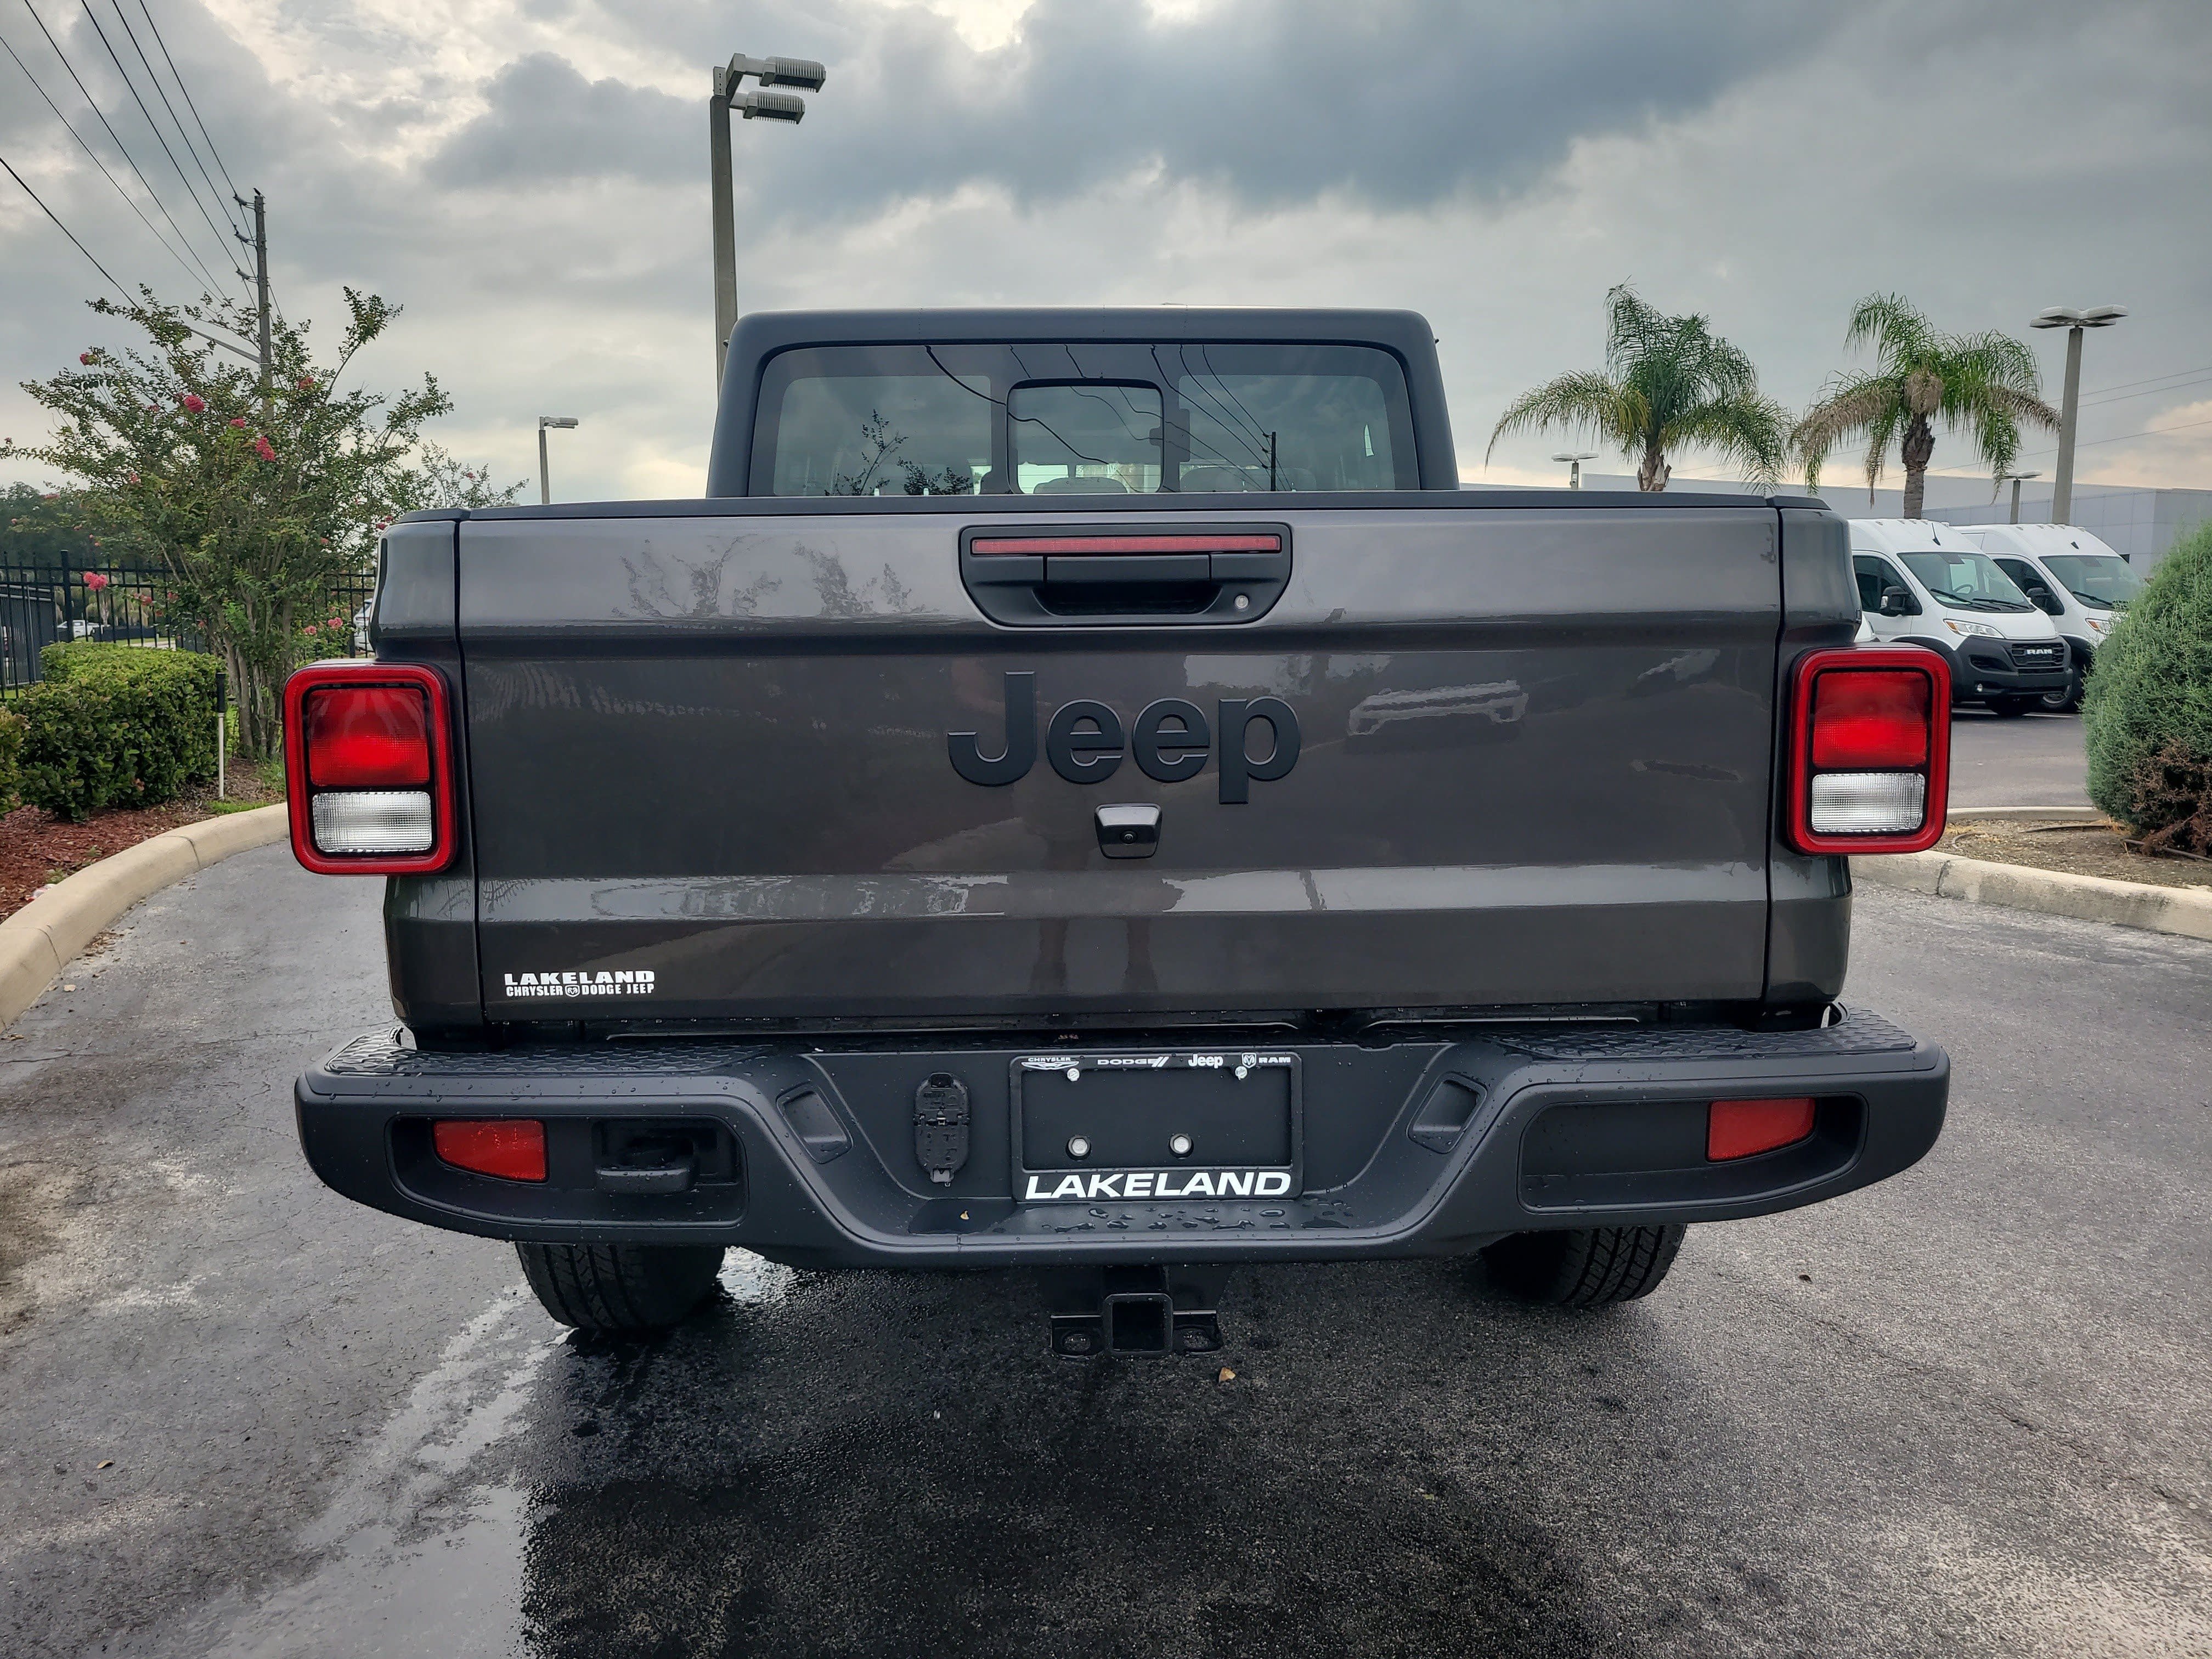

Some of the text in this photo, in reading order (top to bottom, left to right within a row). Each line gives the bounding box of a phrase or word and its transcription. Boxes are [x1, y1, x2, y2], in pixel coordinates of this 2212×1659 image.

[947, 670, 1301, 805] Jeep
[504, 970, 655, 985] LAKELAND
[506, 983, 654, 997] CHRYSLER DODGE JEEP
[1188, 1053, 1223, 1068] Jeep
[1025, 1172, 1291, 1199] LAKELAND
